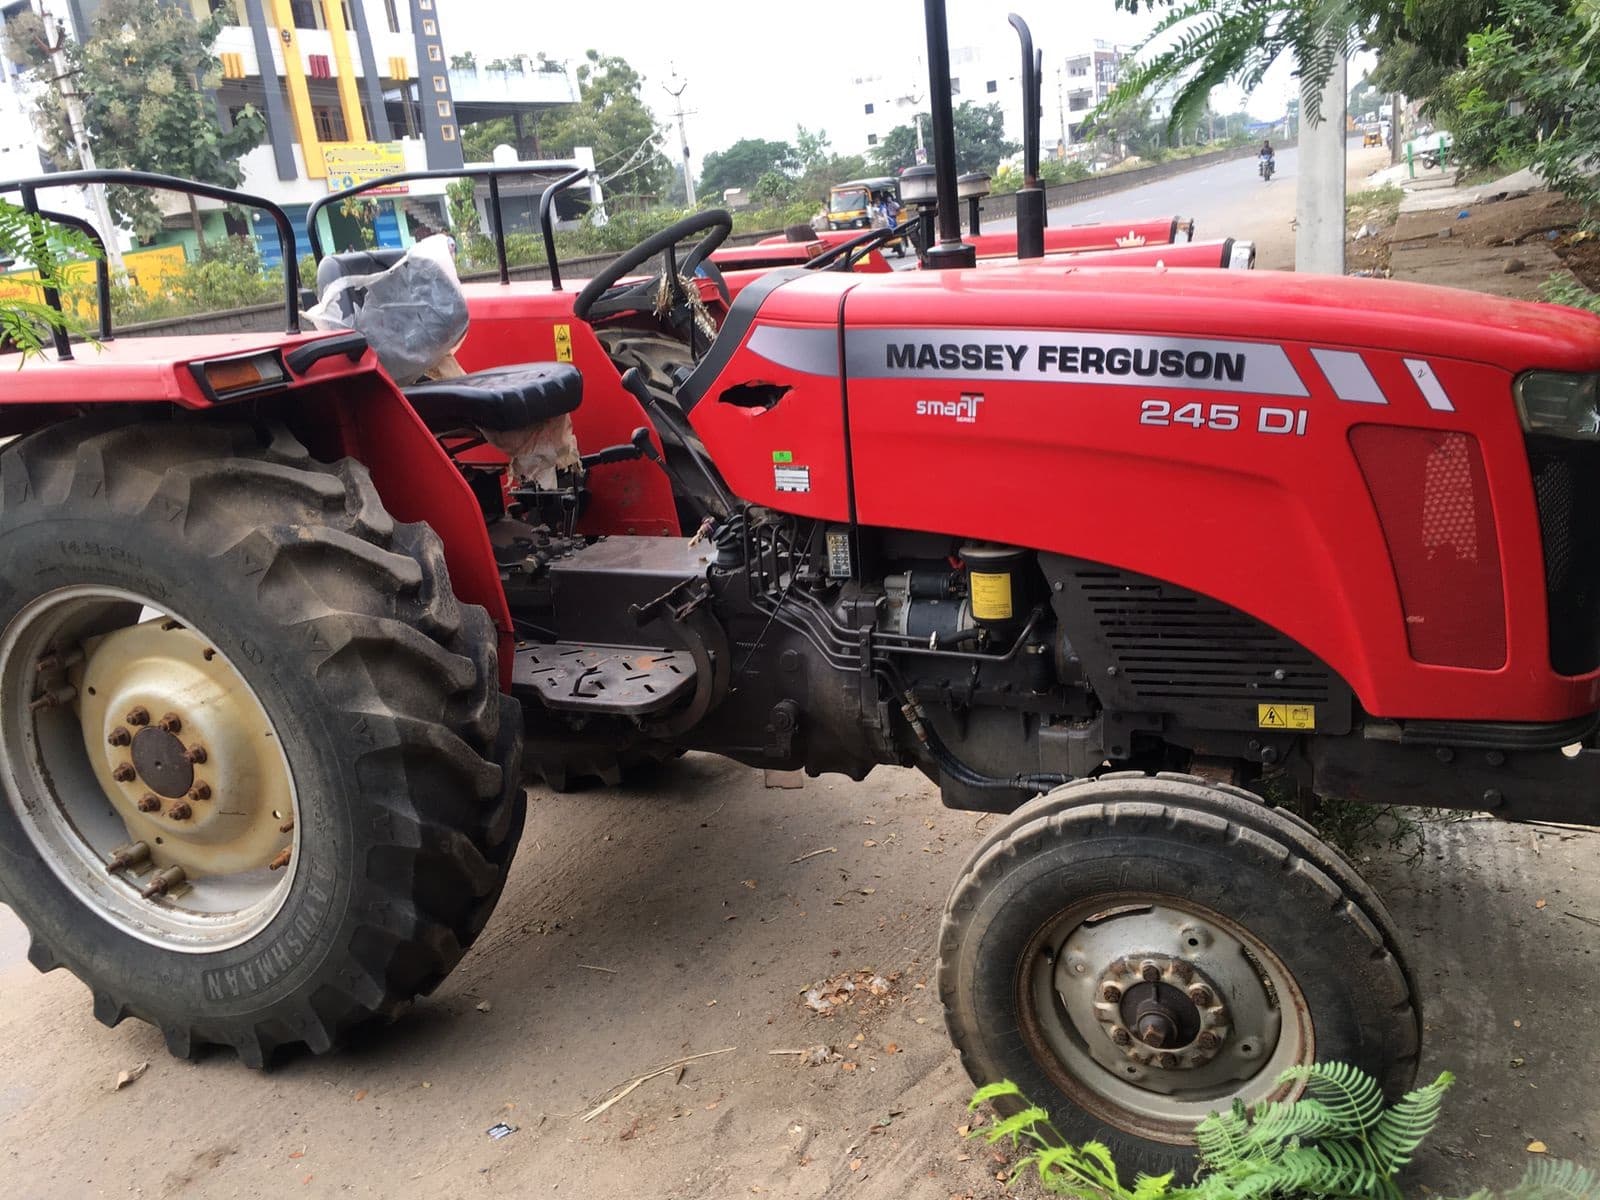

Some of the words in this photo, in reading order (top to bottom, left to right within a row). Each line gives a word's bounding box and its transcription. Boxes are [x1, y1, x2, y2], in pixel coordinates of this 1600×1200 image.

[886, 343, 1028, 371] MASSEY
[1037, 345, 1246, 382] FERGUSON
[1140, 400, 1240, 431] 245
[1257, 406, 1309, 436] DI
